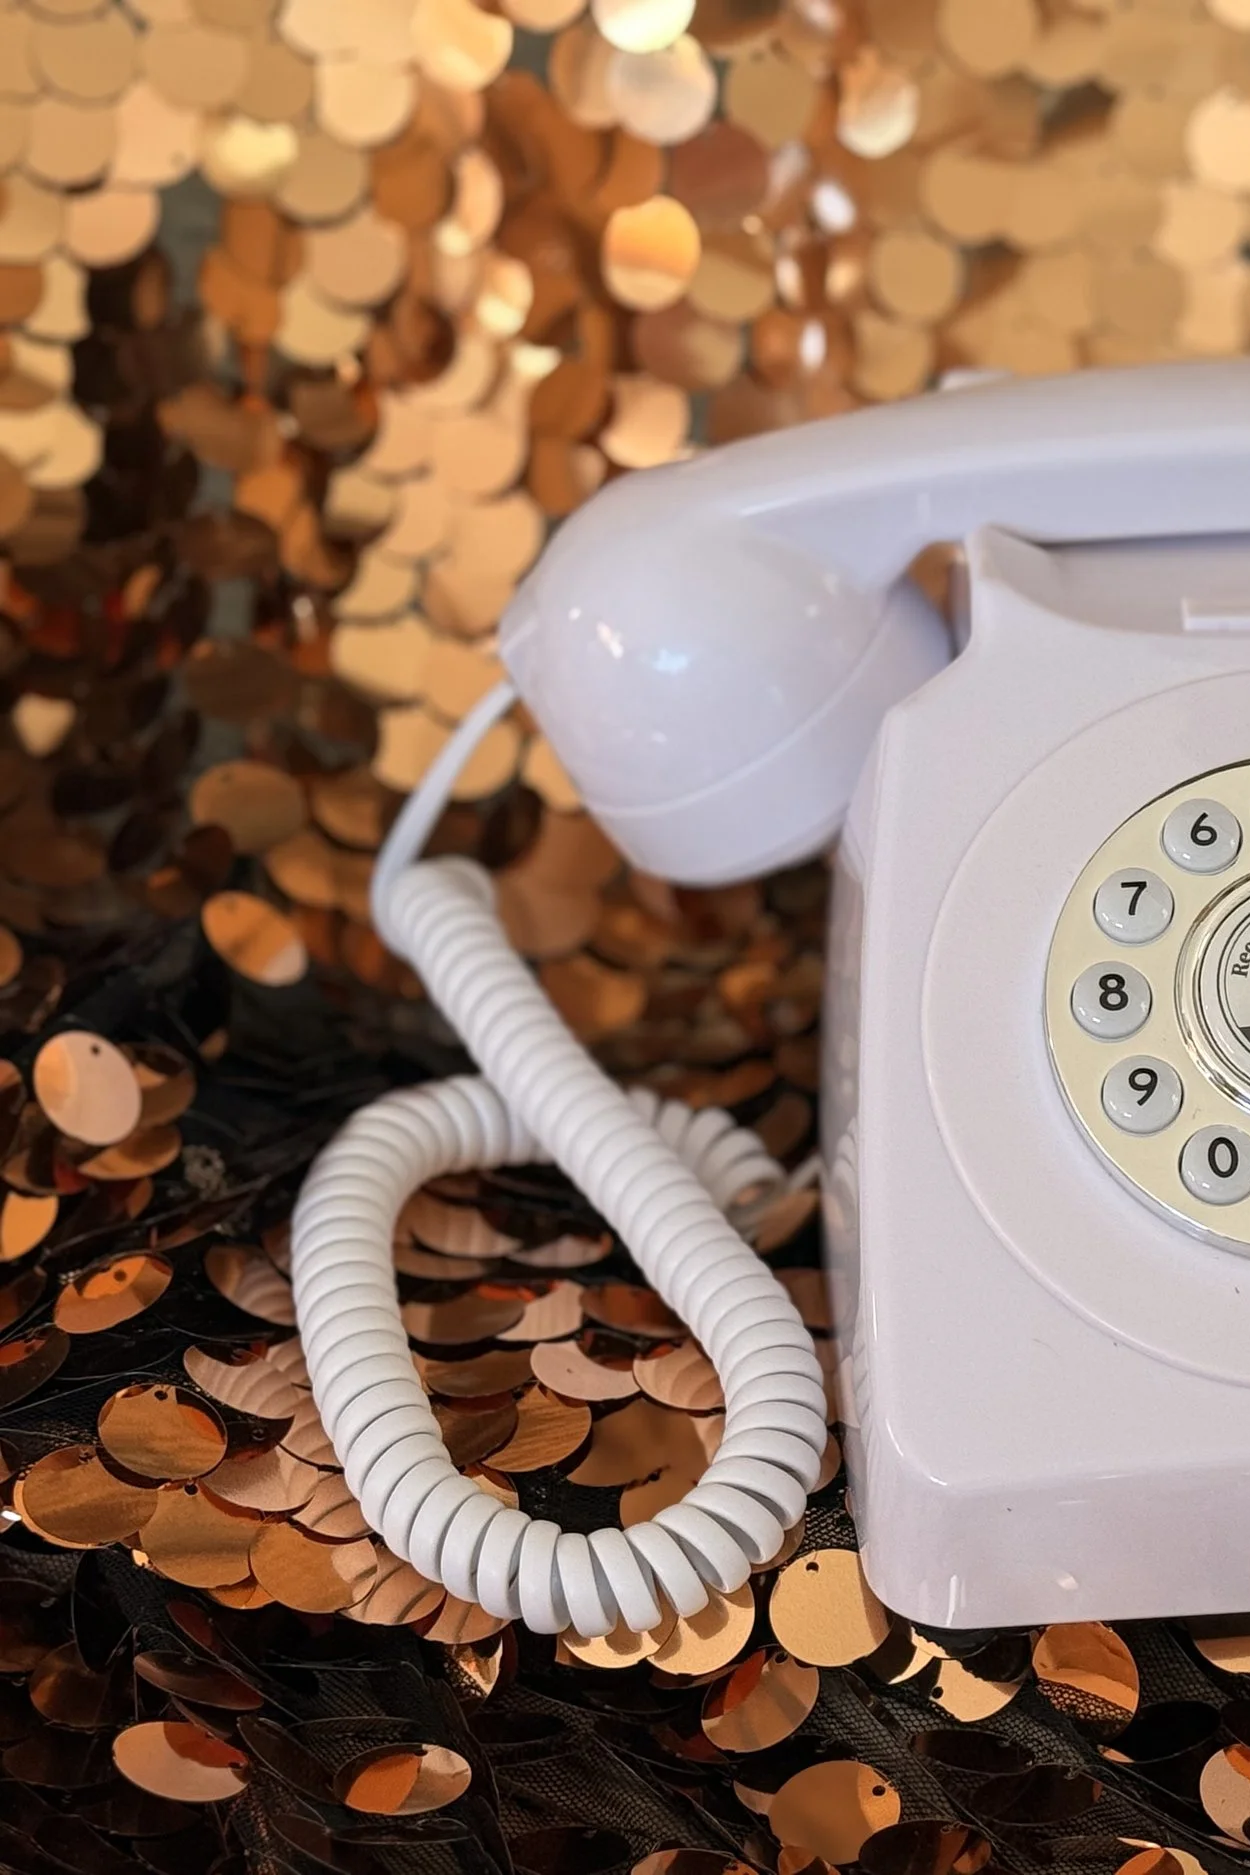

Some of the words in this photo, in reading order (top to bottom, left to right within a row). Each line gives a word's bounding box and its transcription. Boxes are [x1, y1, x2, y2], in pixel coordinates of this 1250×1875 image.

[1190, 812, 1218, 847] 6
[1120, 880, 1148, 916] 7
[1098, 973, 1129, 1012] 8
[1128, 1067, 1158, 1107] 9
[1207, 1136, 1239, 1179] 0
